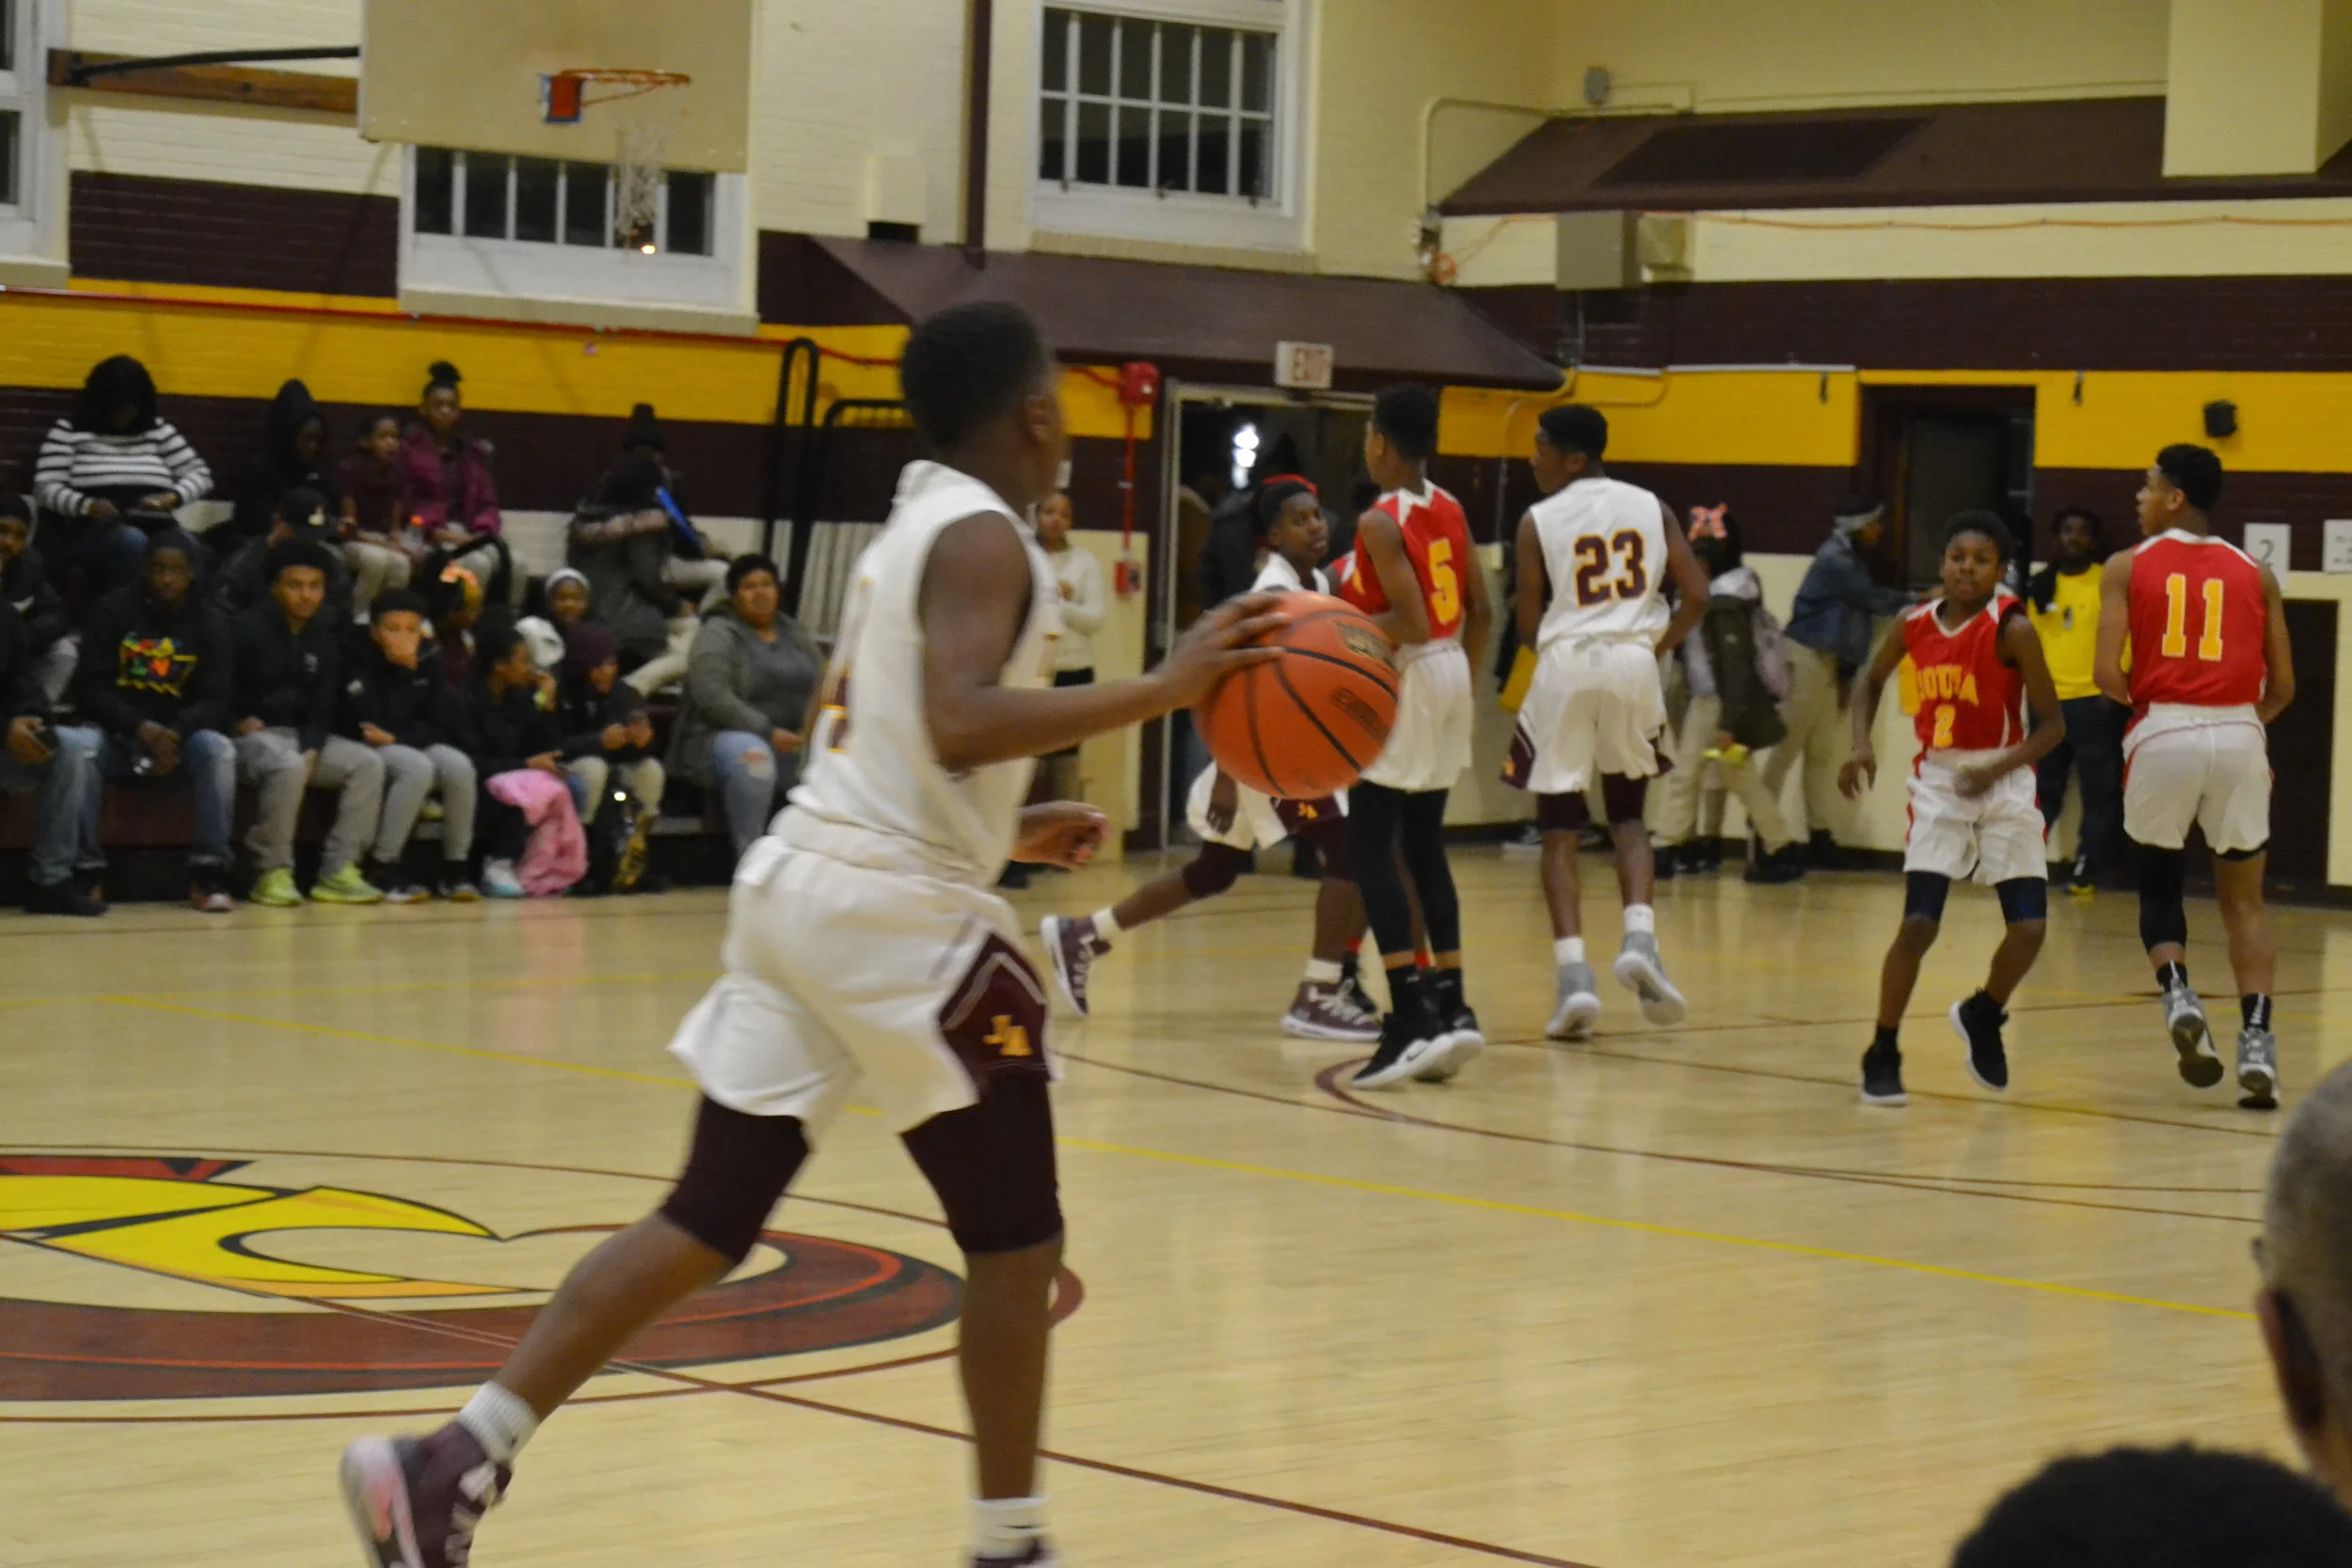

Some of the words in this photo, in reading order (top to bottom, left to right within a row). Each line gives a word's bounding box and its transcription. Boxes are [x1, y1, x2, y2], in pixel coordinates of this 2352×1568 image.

[1427, 537, 1459, 626] 5
[1574, 528, 1647, 609] 23
[2162, 572, 2223, 661] 11
